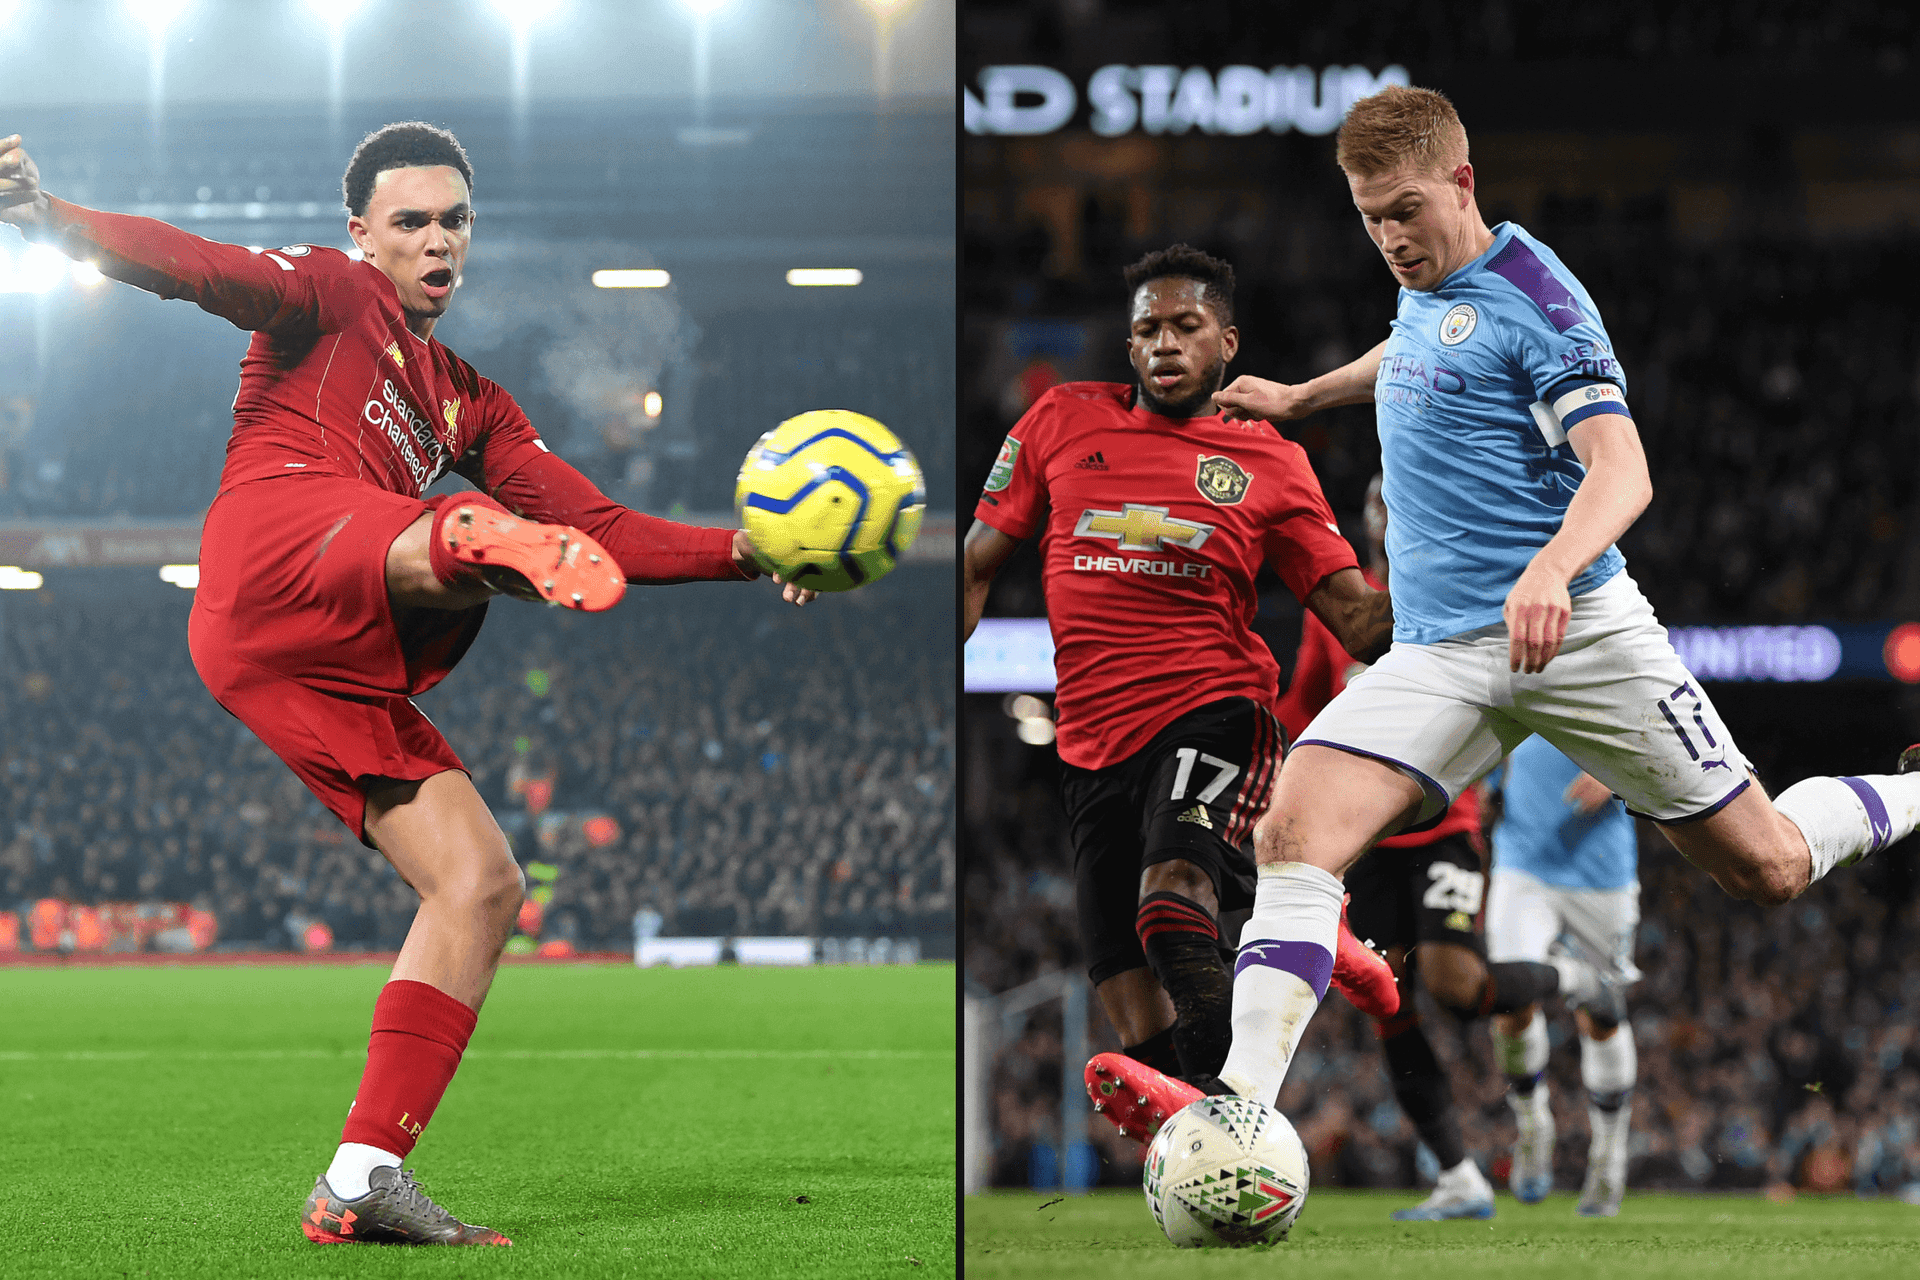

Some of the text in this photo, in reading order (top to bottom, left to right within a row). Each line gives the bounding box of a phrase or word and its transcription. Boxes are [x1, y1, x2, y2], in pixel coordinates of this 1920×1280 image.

[364, 400, 429, 485] Chartered
[382, 378, 443, 460] Standard
[1074, 555, 1213, 578] CHEVROLET
[1657, 680, 1717, 761] 17
[1170, 747, 1240, 804] 17
[1177, 813, 1213, 829] adidas
[1423, 860, 1484, 915] 29
